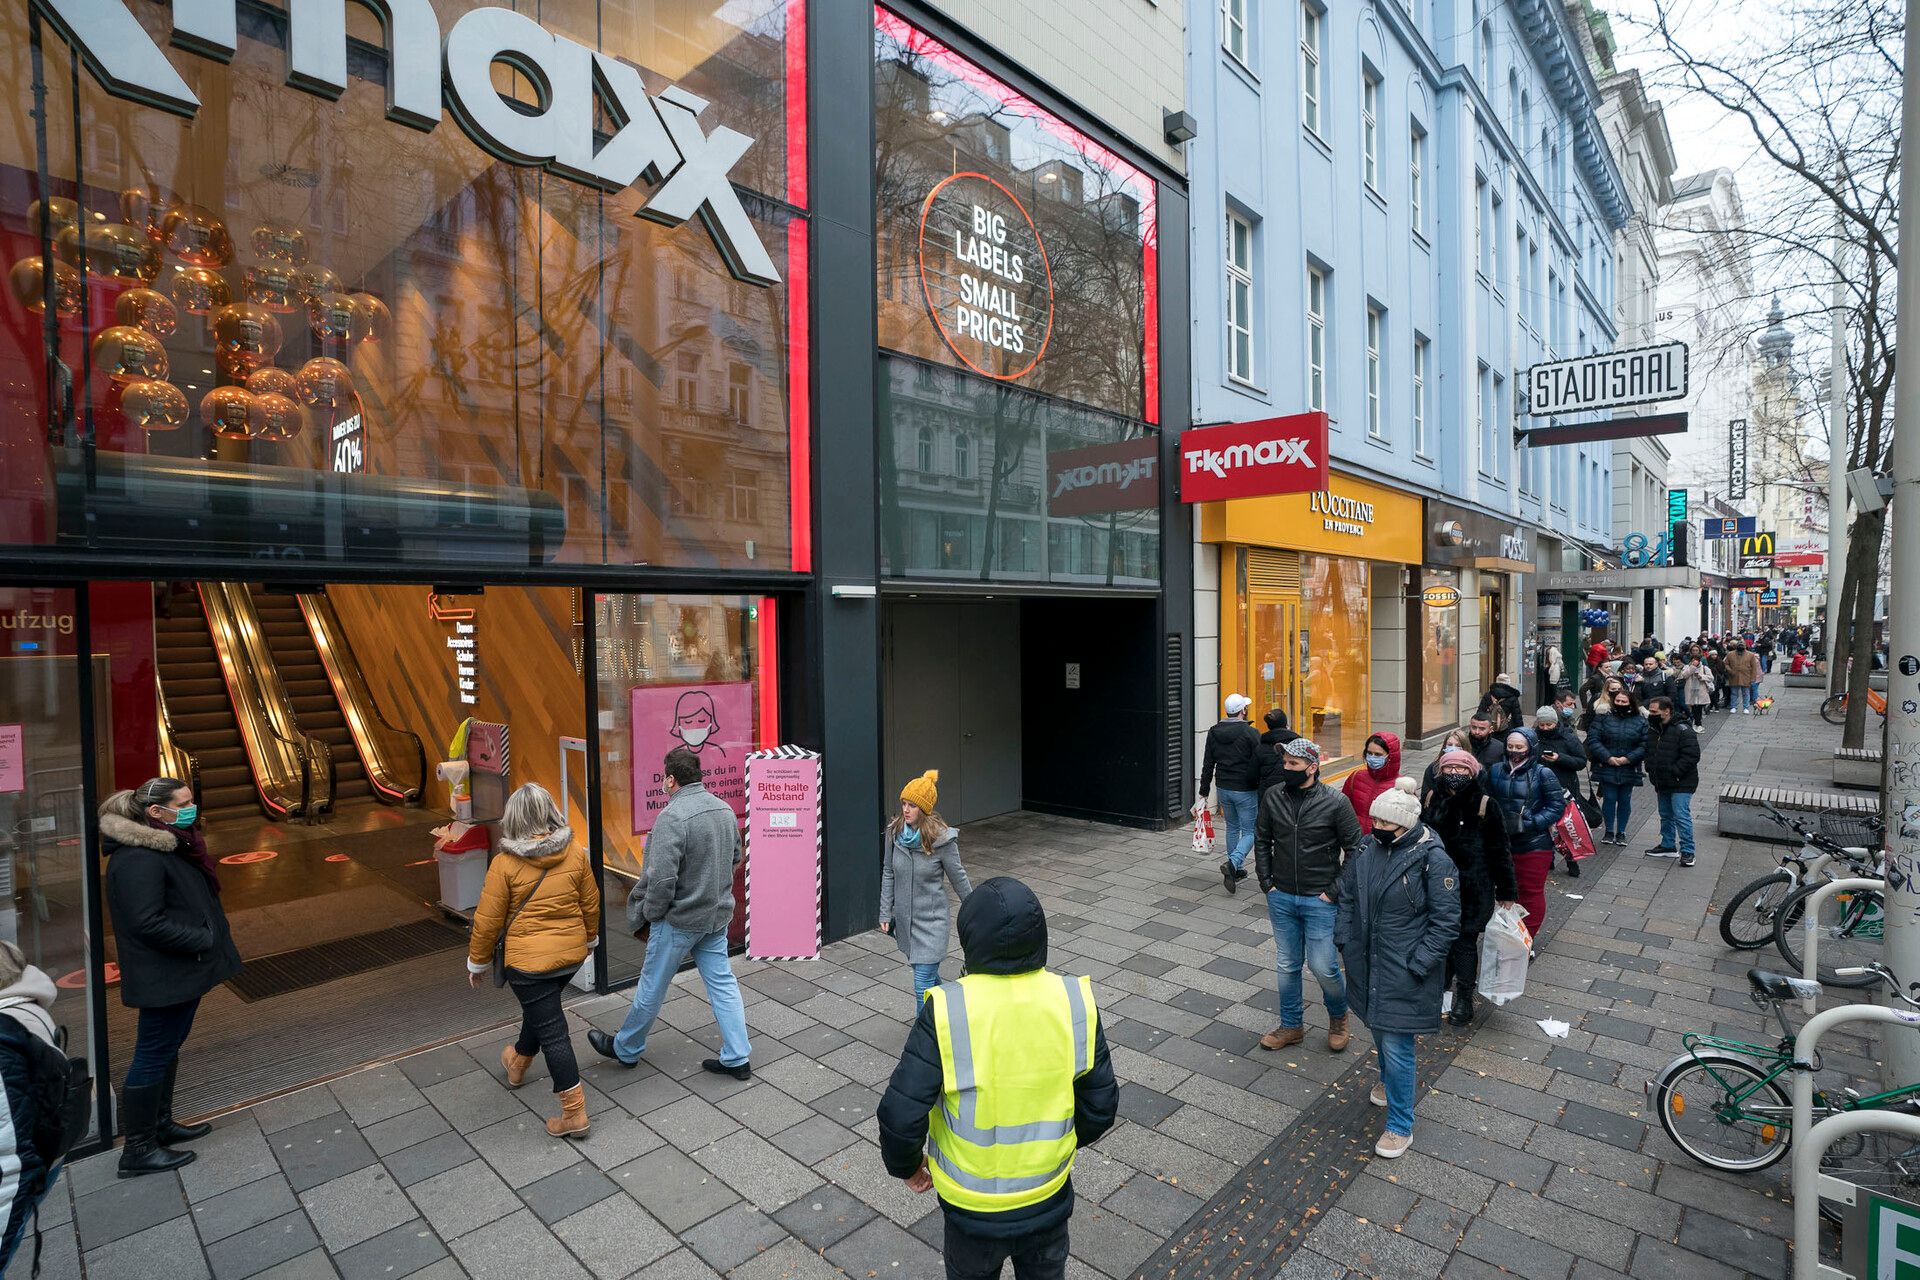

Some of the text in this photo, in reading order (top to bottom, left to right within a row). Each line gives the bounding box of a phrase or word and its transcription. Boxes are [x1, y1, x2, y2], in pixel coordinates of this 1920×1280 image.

[27, 0, 782, 287] maxx
[973, 204, 1007, 245] BIG
[956, 229, 1024, 284] LABELS
[959, 272, 1020, 322] SMALL
[957, 305, 1024, 354] PRICES
[1536, 351, 1678, 408] STADTSAAL
[333, 437, 362, 474] 60%
[1310, 490, 1374, 523] L'OCCITANE
[1668, 491, 1686, 551] KDAY
[1323, 518, 1365, 536] EN PROVENCE
[1621, 531, 1667, 568] 81
[1423, 592, 1458, 600] FOSSIL
[0, 609, 74, 635] ufzug
[572, 638, 651, 678] VENNA
[703, 780, 717, 789] ore
[719, 777, 743, 786] einen
[714, 765, 726, 775] du
[728, 764, 737, 774] in
[757, 782, 809, 791] Bitte halte
[761, 792, 805, 801] Abstand
